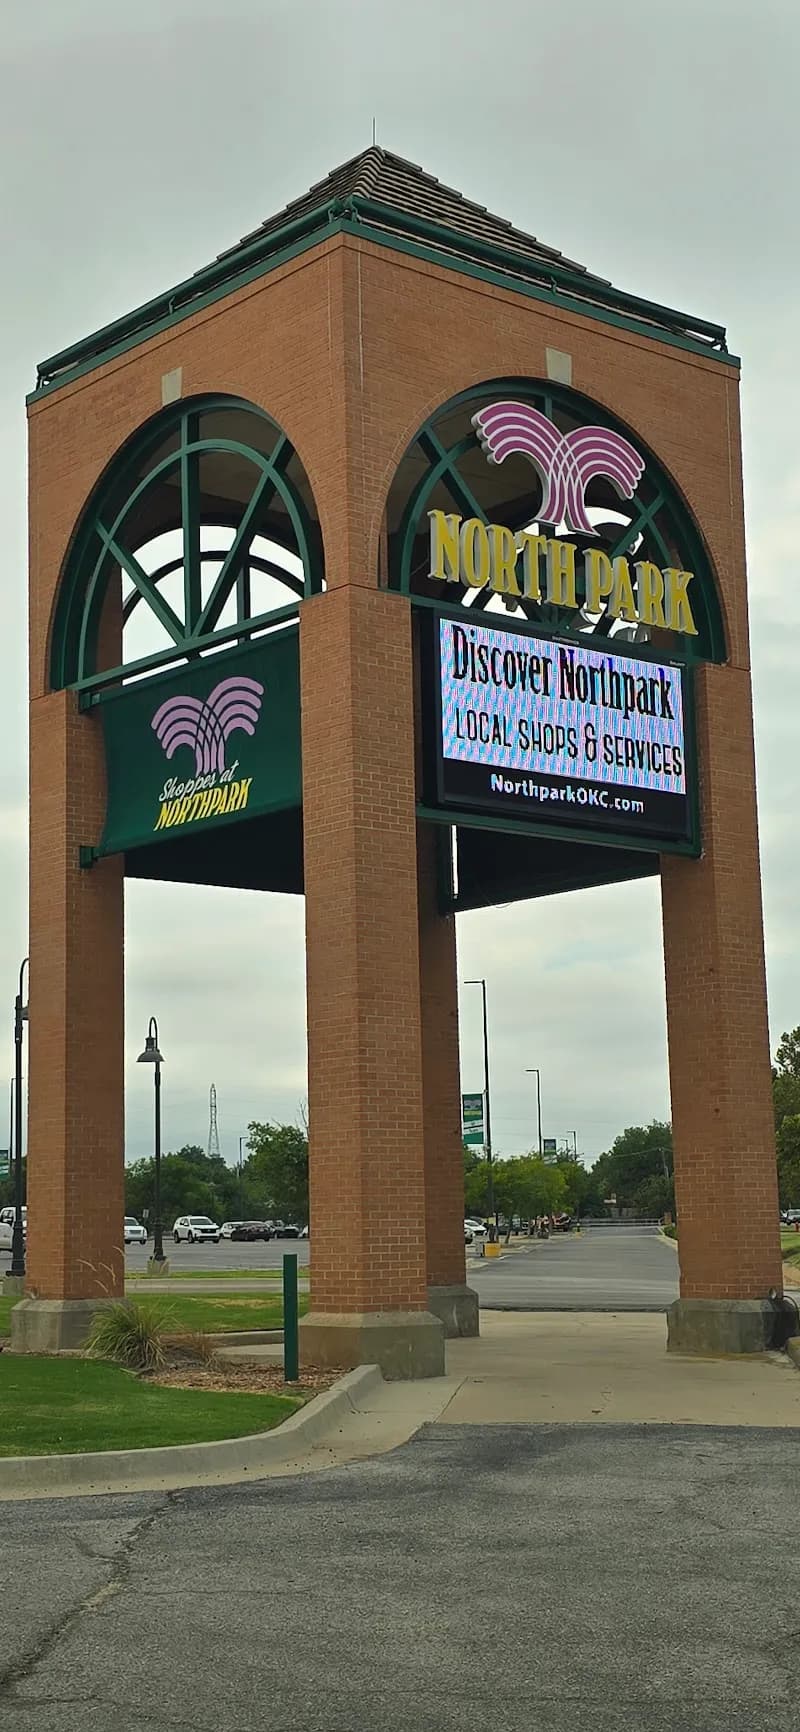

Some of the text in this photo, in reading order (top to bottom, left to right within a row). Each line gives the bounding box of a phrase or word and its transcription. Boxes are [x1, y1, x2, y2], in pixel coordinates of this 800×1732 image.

[427, 509, 699, 635] NORTH PARK
[452, 624, 674, 720] Discover Northpark
[456, 708, 683, 776] LOCAL SHOPS & SERVICES
[154, 778, 253, 831] NORTHPARK
[159, 760, 239, 802] Shoppes at
[490, 773, 645, 813] NorthparkOKC.com
